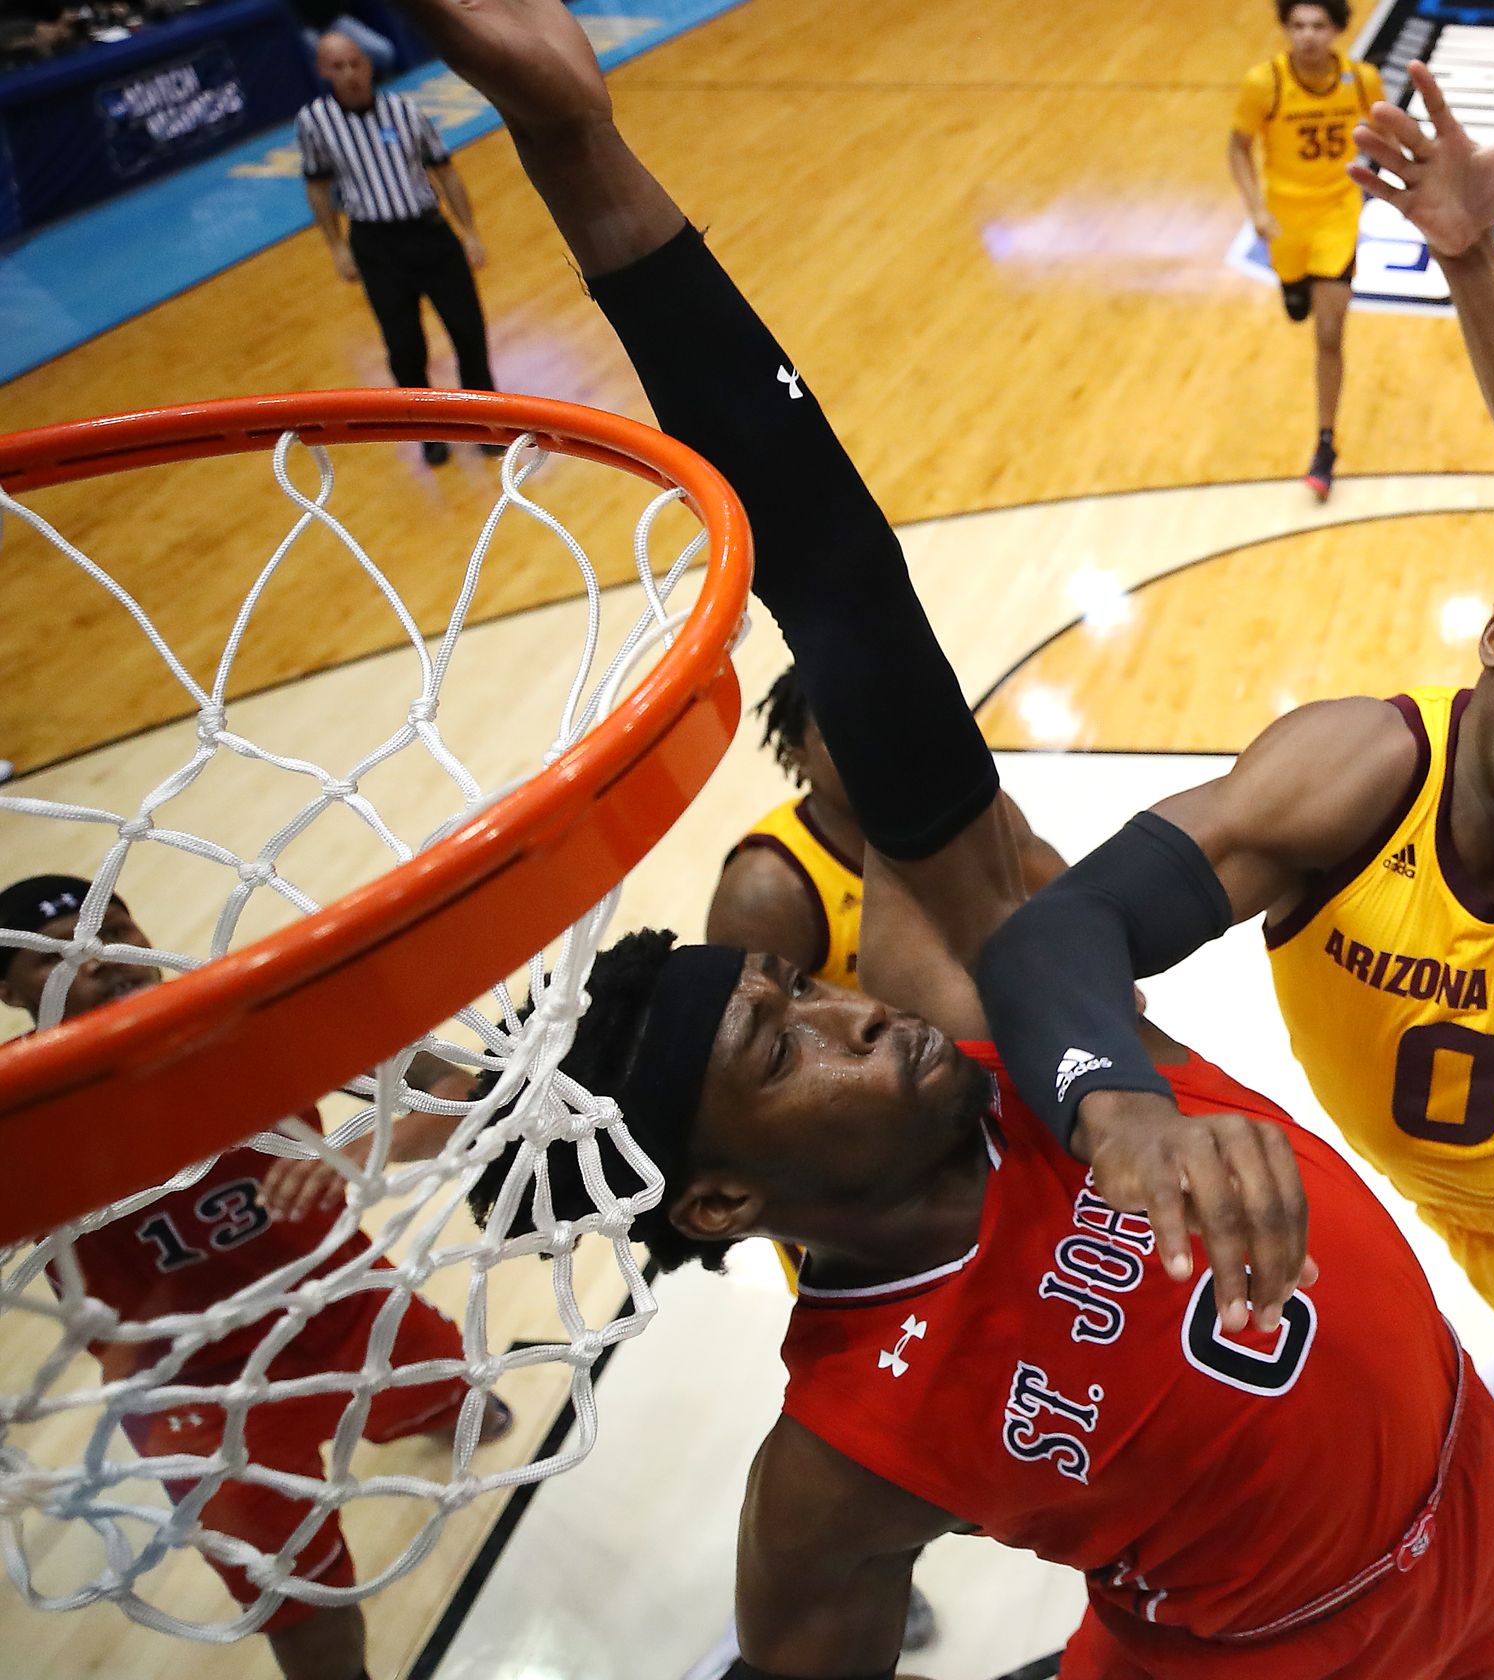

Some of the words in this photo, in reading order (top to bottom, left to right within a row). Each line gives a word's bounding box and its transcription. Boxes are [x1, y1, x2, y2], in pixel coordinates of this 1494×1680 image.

[1297, 122, 1349, 161] 35
[1323, 927, 1489, 1010] ARIZONA
[1057, 1057, 1113, 1103] adidas
[135, 1177, 273, 1273] 13
[1038, 1165, 1156, 1345] JOH
[1181, 1265, 1318, 1397] 0
[1002, 1360, 1105, 1486] ST.
